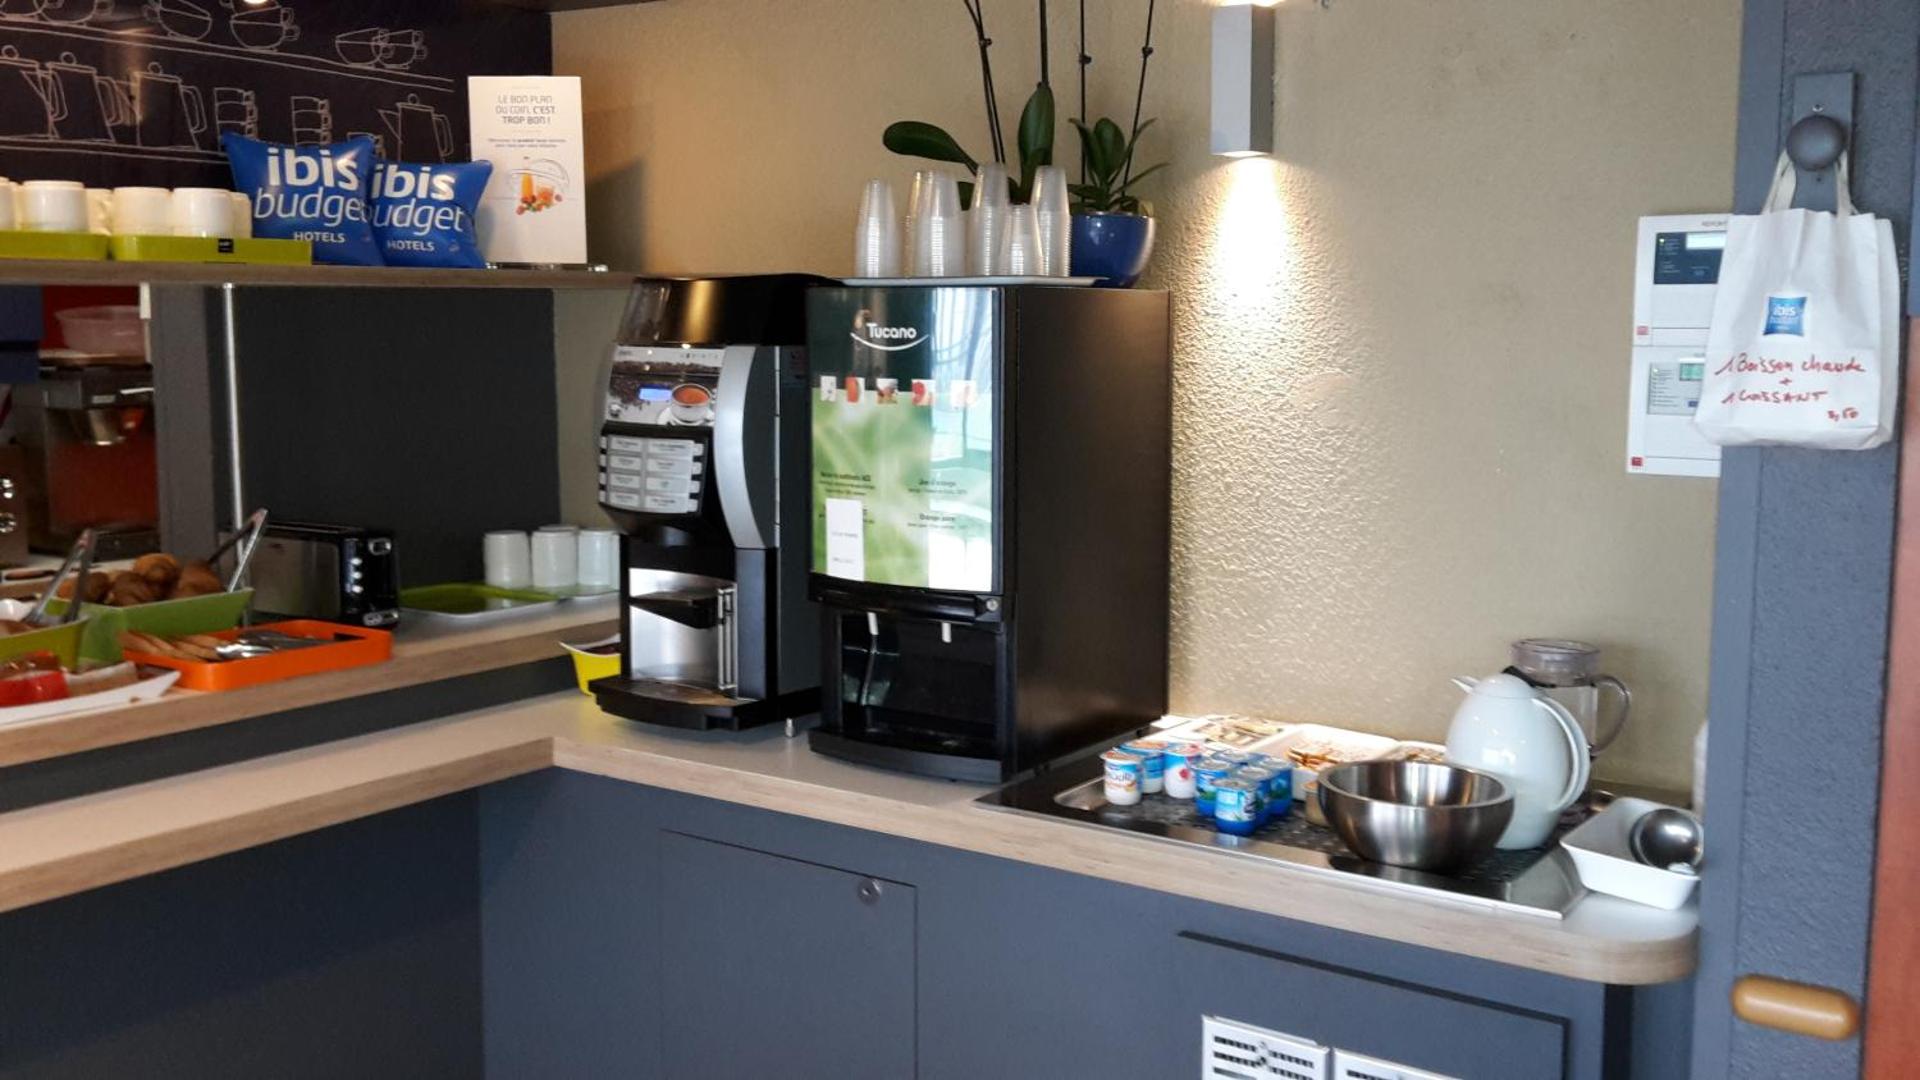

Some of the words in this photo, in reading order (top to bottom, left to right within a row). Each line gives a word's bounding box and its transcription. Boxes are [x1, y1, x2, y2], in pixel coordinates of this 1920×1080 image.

[502, 116, 526, 124] TROP
[527, 116, 546, 125] BON
[267, 147, 360, 192] ibis
[371, 163, 456, 202] ibis
[371, 198, 465, 237] udget
[293, 230, 346, 244] HOTELS
[386, 240, 435, 252] HOTELS
[865, 322, 917, 339] Tucano
